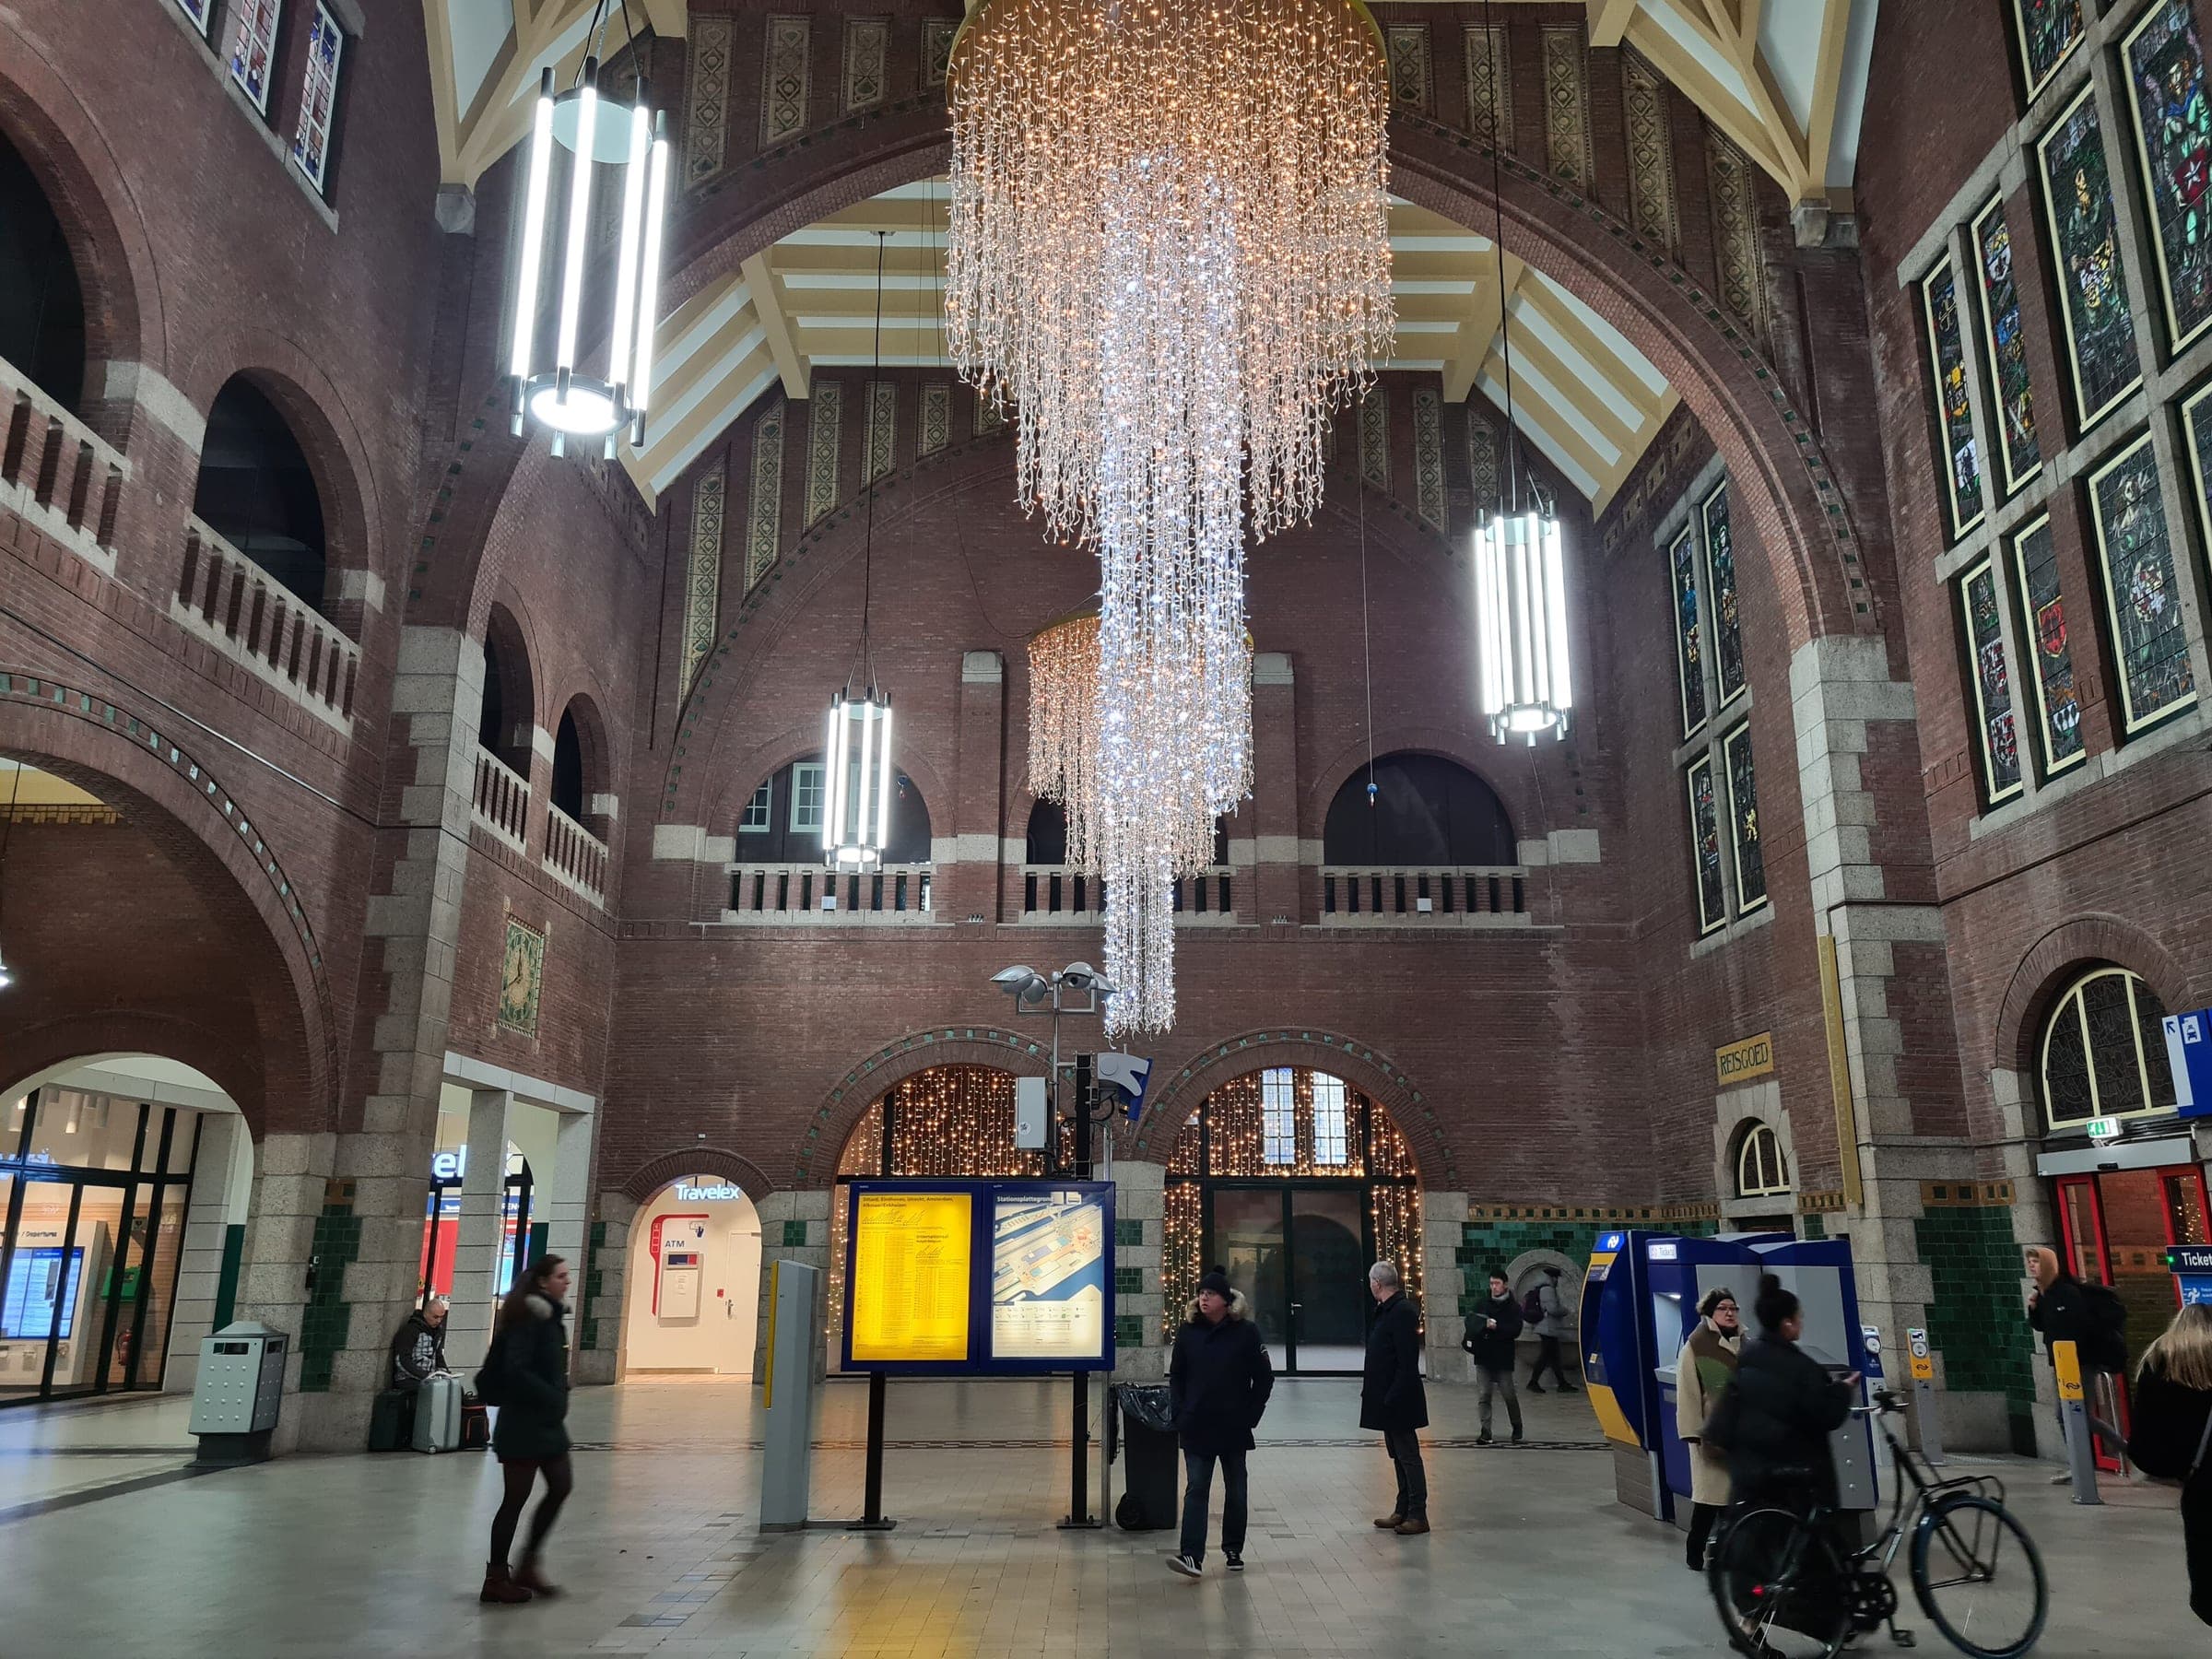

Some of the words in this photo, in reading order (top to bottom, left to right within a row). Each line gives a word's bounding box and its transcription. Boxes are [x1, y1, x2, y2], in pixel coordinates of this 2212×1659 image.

[1720, 1042, 1769, 1076] REISGOED
[676, 1183, 740, 1201] Travelex
[665, 1240, 686, 1248] ATM
